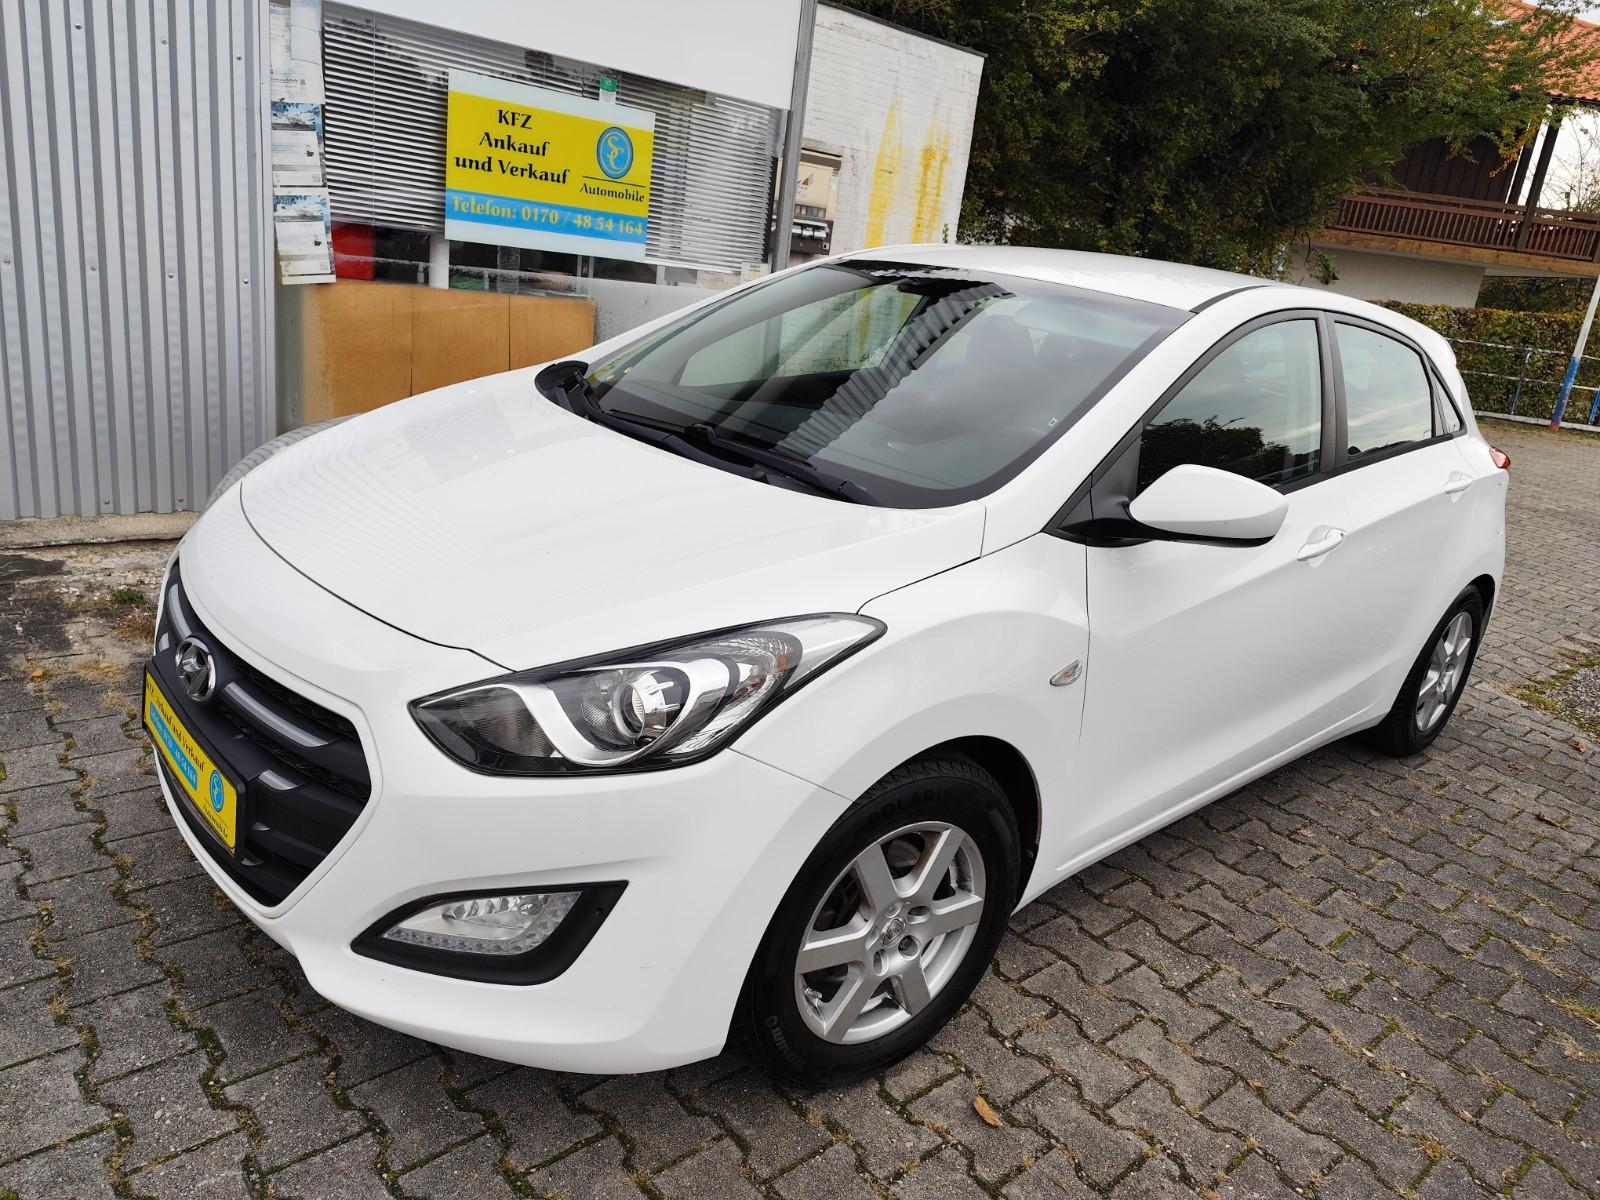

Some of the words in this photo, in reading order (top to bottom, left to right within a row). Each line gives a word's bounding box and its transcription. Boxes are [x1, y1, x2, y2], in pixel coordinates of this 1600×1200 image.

[498, 109, 532, 130] KFZ
[479, 131, 551, 157] Ankauf
[454, 156, 493, 173] und
[498, 159, 571, 185] Verkauf
[580, 183, 645, 203] Automobile
[451, 195, 517, 220] Telefon:
[521, 205, 559, 225] 0170
[574, 213, 592, 229] 48
[595, 216, 613, 233] 54
[619, 219, 643, 237] 164
